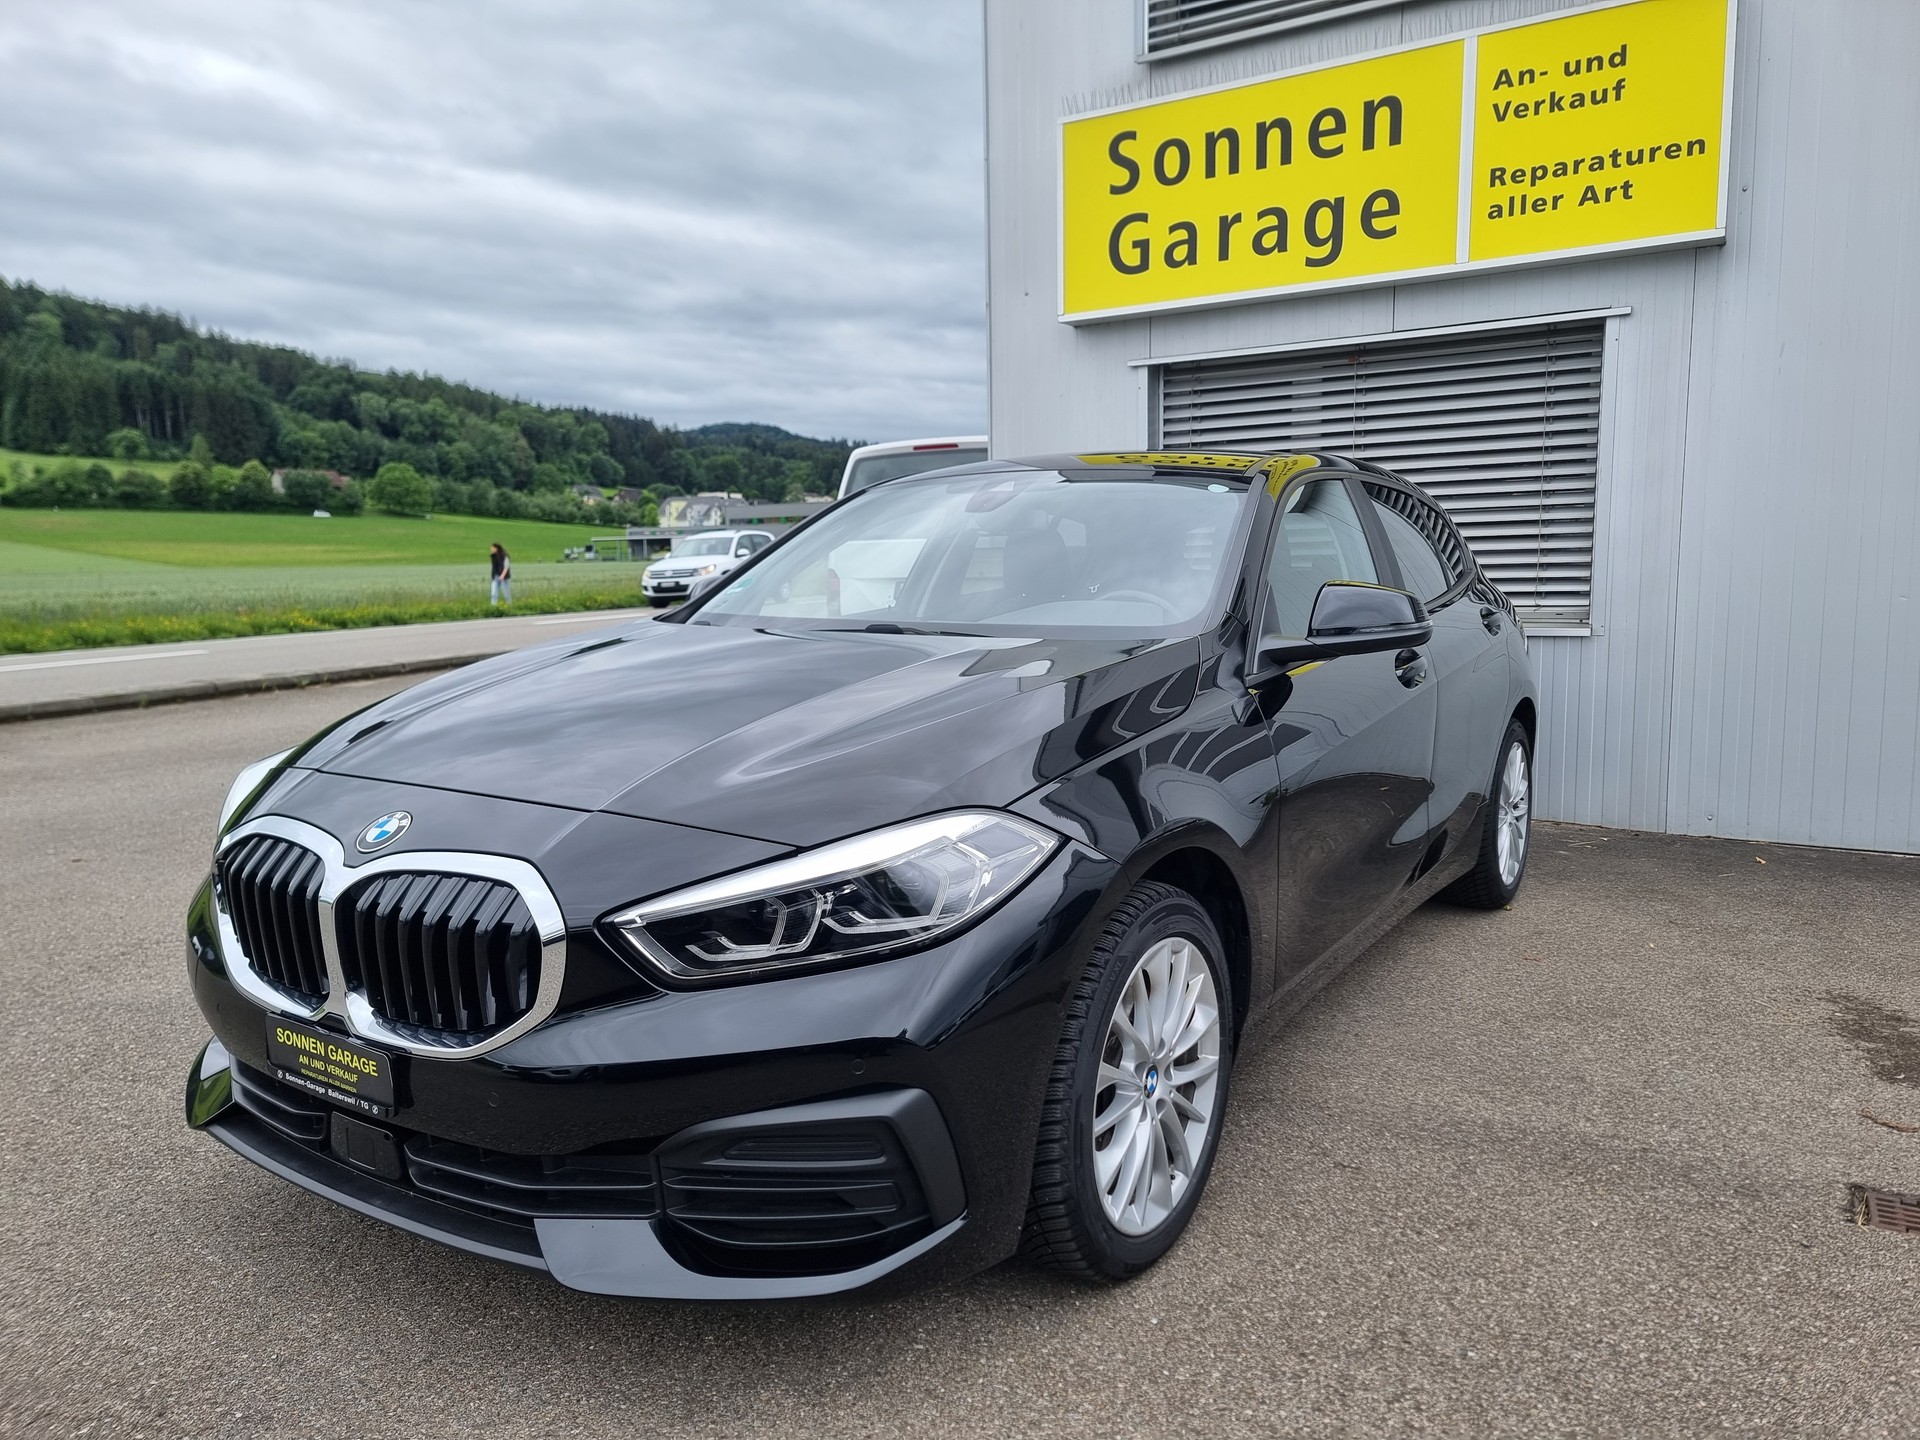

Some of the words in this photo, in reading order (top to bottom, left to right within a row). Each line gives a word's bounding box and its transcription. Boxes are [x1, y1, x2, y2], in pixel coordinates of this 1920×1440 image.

[1492, 68, 1549, 91] An-
[1563, 44, 1628, 77] und
[1492, 78, 1627, 123] Verkauf
[1107, 95, 1403, 195] Sonnen
[1489, 138, 1707, 188] Reparaturen
[1487, 193, 1565, 220] aller
[1577, 179, 1634, 207] Art
[1107, 187, 1401, 275] Garage
[276, 1027, 325, 1057] SONNEN
[327, 1045, 378, 1077] GARAGE
[299, 1054, 309, 1066] AN
[310, 1058, 325, 1071] UND
[326, 1063, 358, 1083] VERKAUF
[285, 1072, 326, 1094] Sonnen-Garage
[360, 1100, 369, 1110] TG
